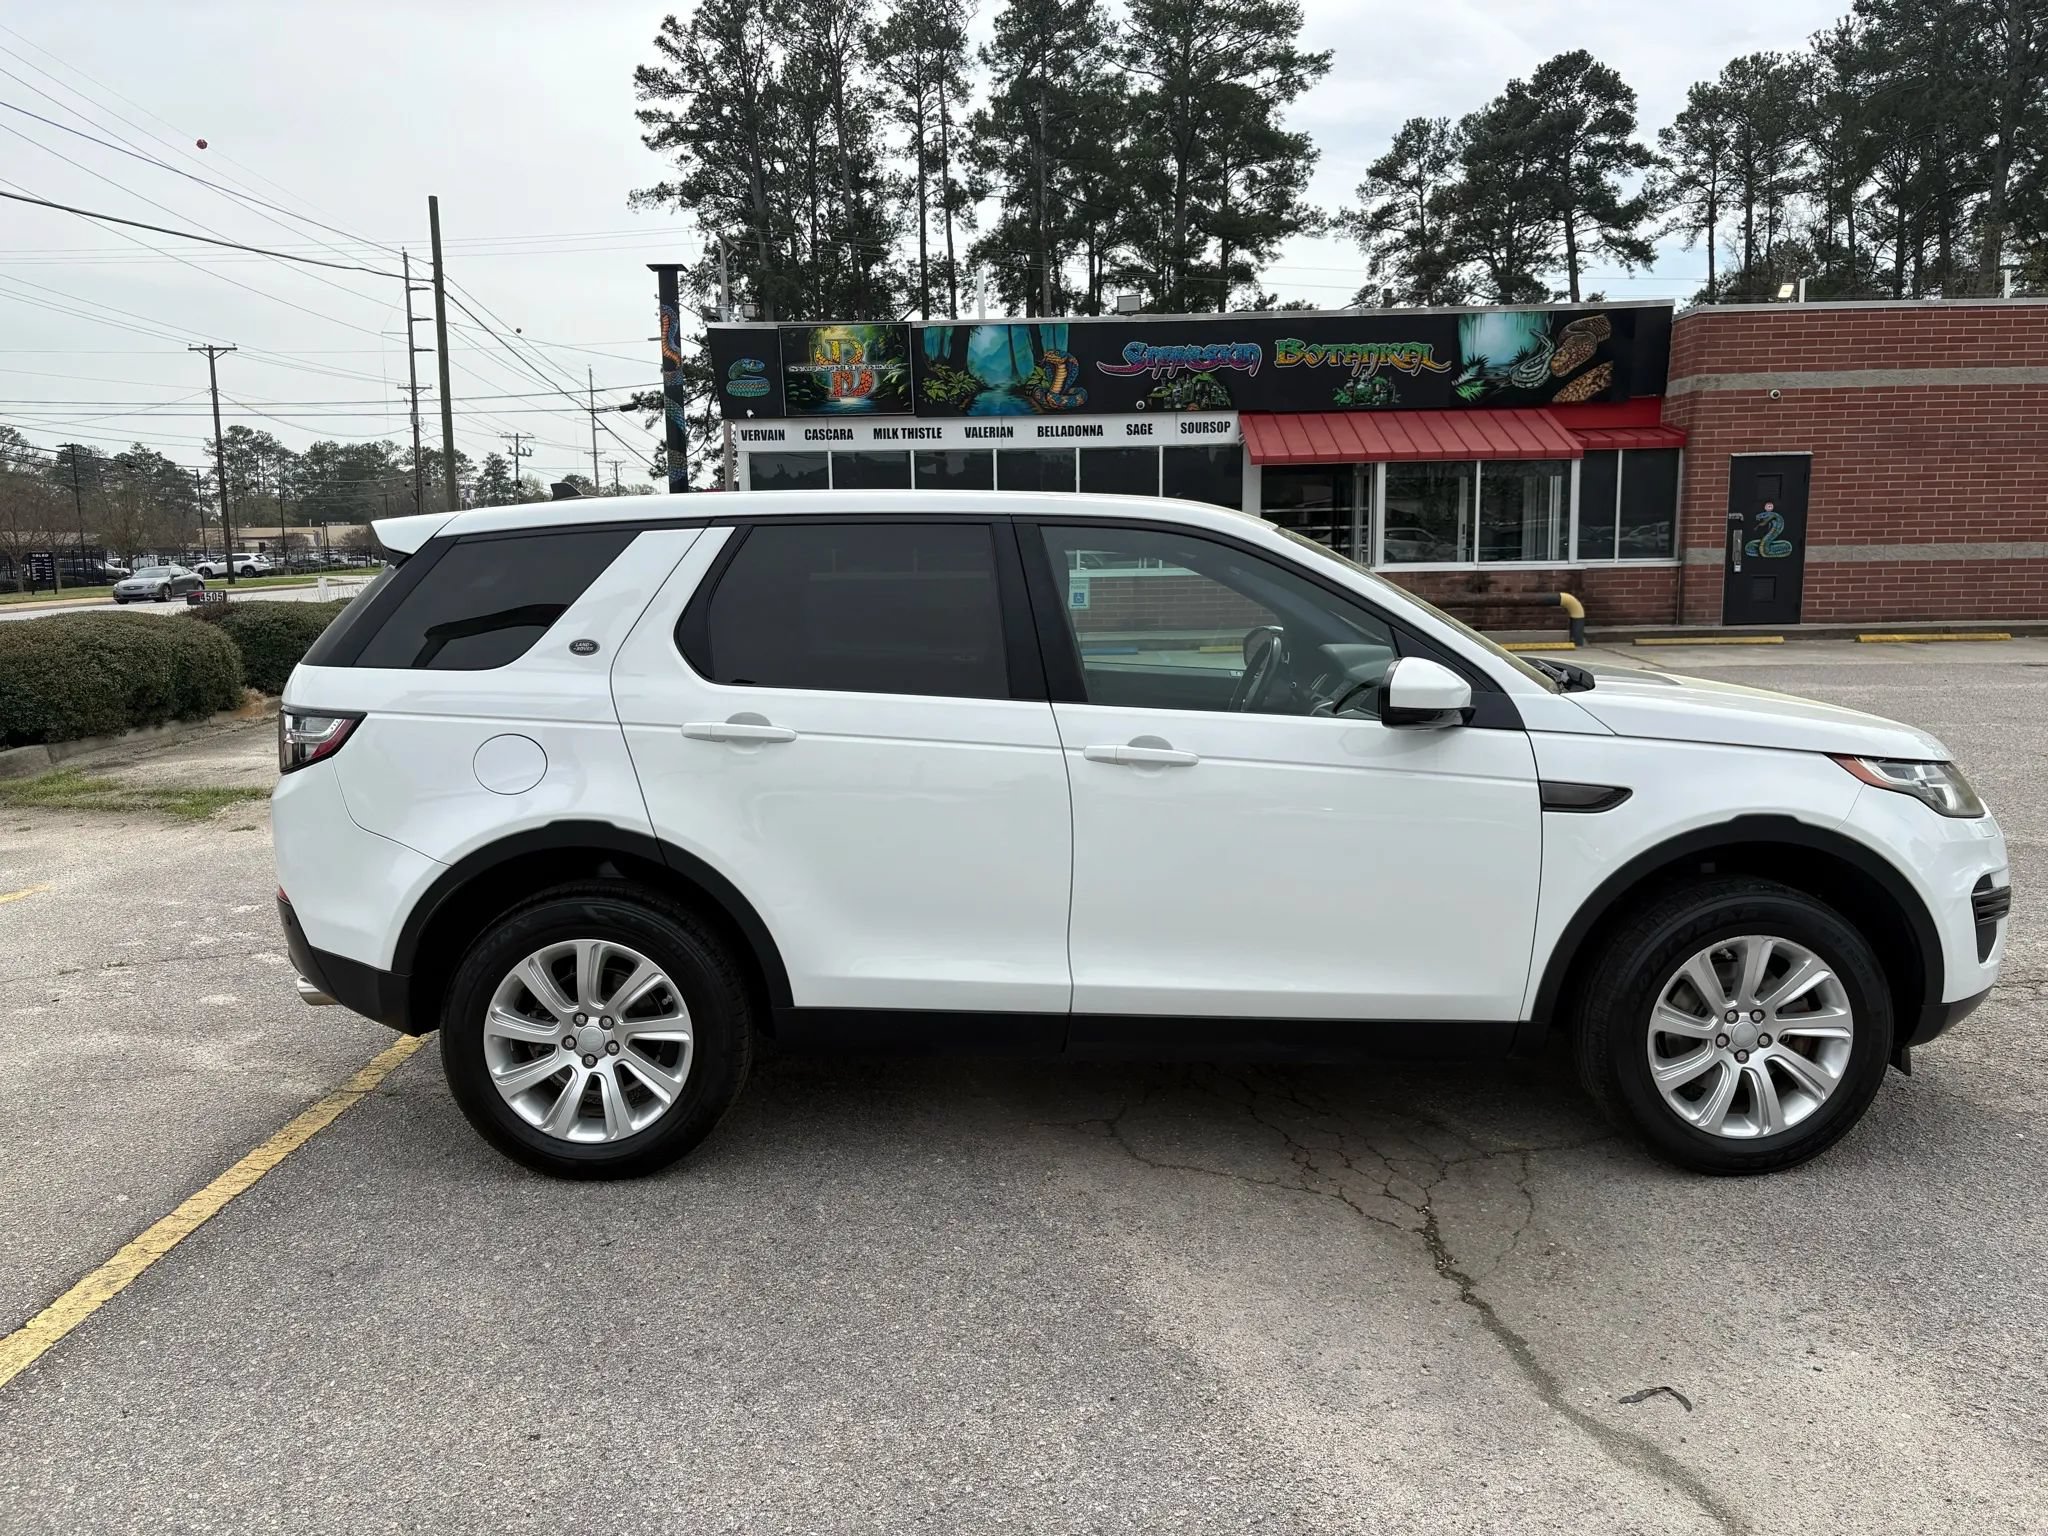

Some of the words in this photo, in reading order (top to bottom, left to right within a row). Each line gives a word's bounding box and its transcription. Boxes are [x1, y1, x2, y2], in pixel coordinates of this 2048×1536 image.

[740, 429, 786, 441] VERVAIN
[804, 428, 854, 441] CASCARA
[873, 427, 899, 440] MILK
[900, 427, 943, 439] THISTLE
[964, 426, 1014, 439] VALERIAN
[1037, 424, 1104, 438] BELLADONNA
[1126, 423, 1153, 436] SAGE
[1180, 421, 1231, 434] SOURSOP
[200, 591, 223, 602] 4505
